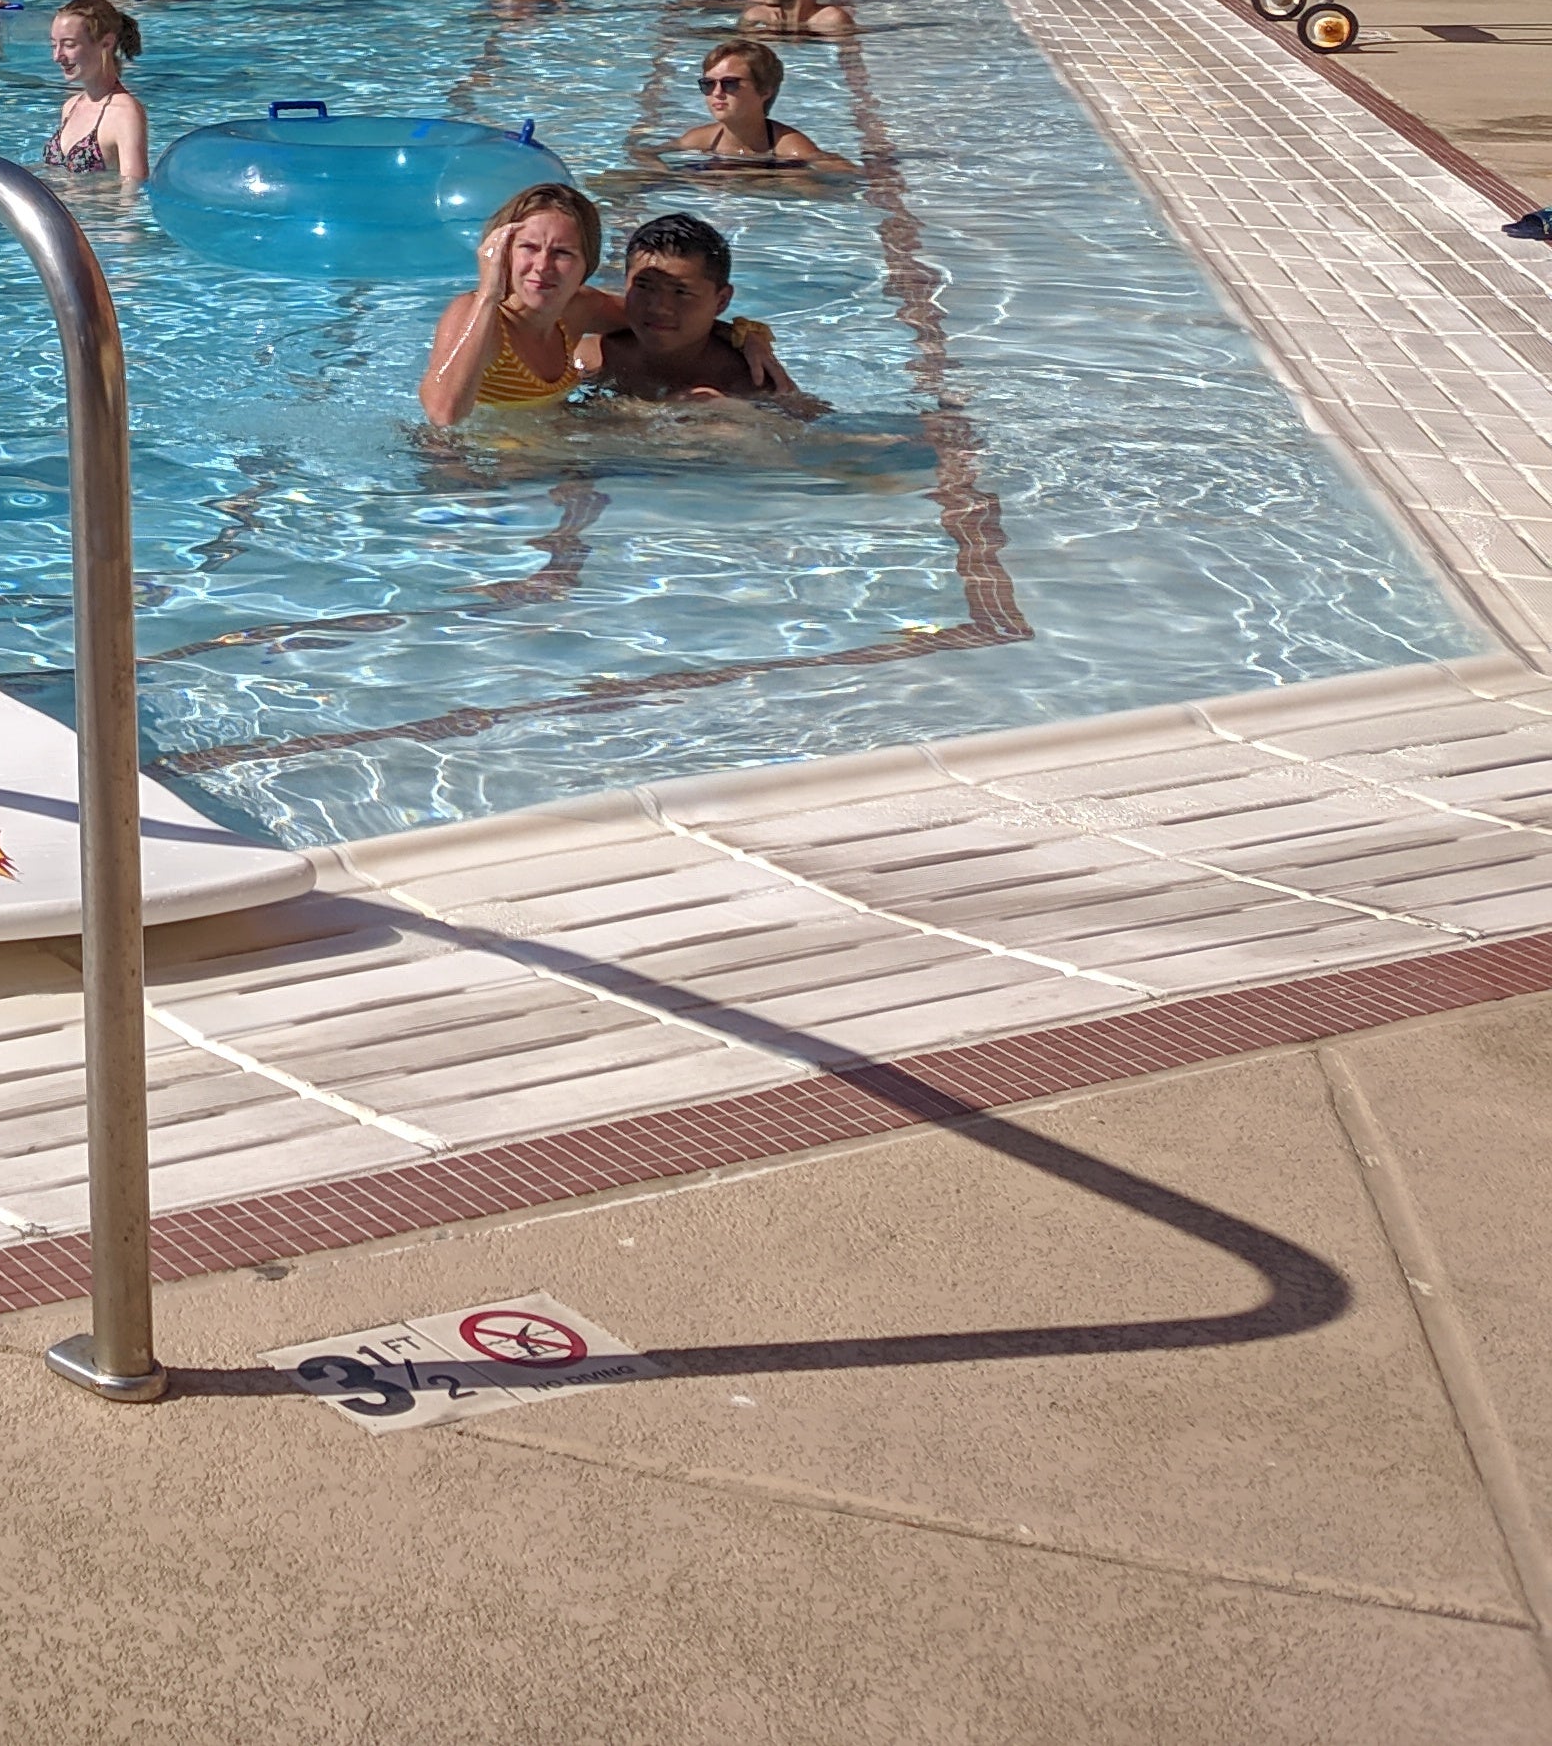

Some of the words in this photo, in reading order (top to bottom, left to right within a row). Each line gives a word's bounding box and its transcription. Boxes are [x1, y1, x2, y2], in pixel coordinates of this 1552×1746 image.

[381, 1335, 421, 1355] FT
[529, 1379, 564, 1393] NO
[564, 1365, 637, 1385] DIVING
